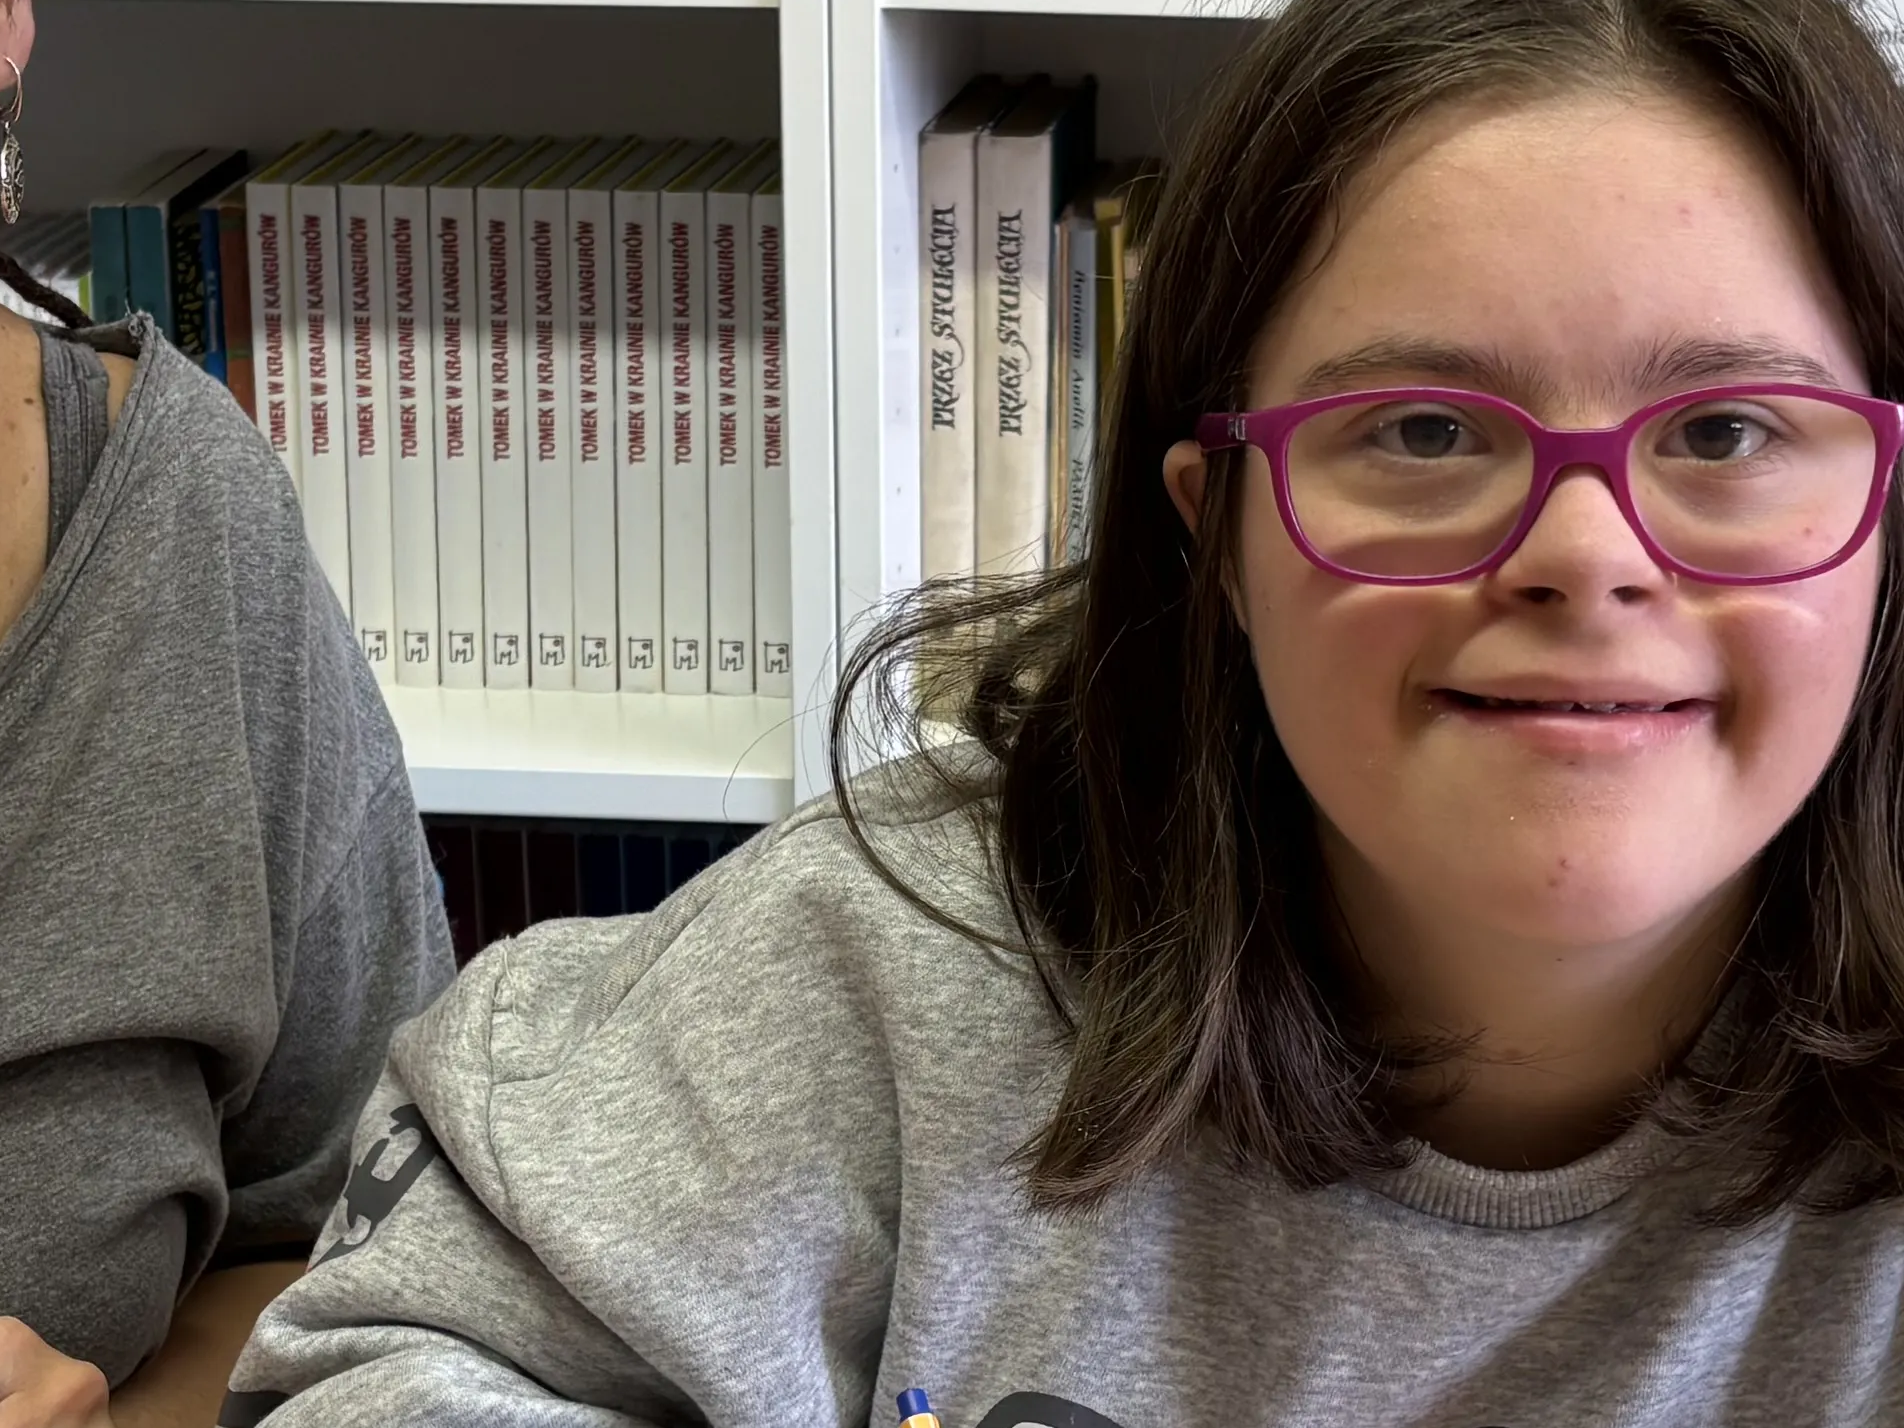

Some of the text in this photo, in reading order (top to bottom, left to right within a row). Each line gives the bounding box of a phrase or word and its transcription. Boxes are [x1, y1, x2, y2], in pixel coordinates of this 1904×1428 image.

[622, 222, 646, 464] TOMEK W KRAINIE KANGURÓW
